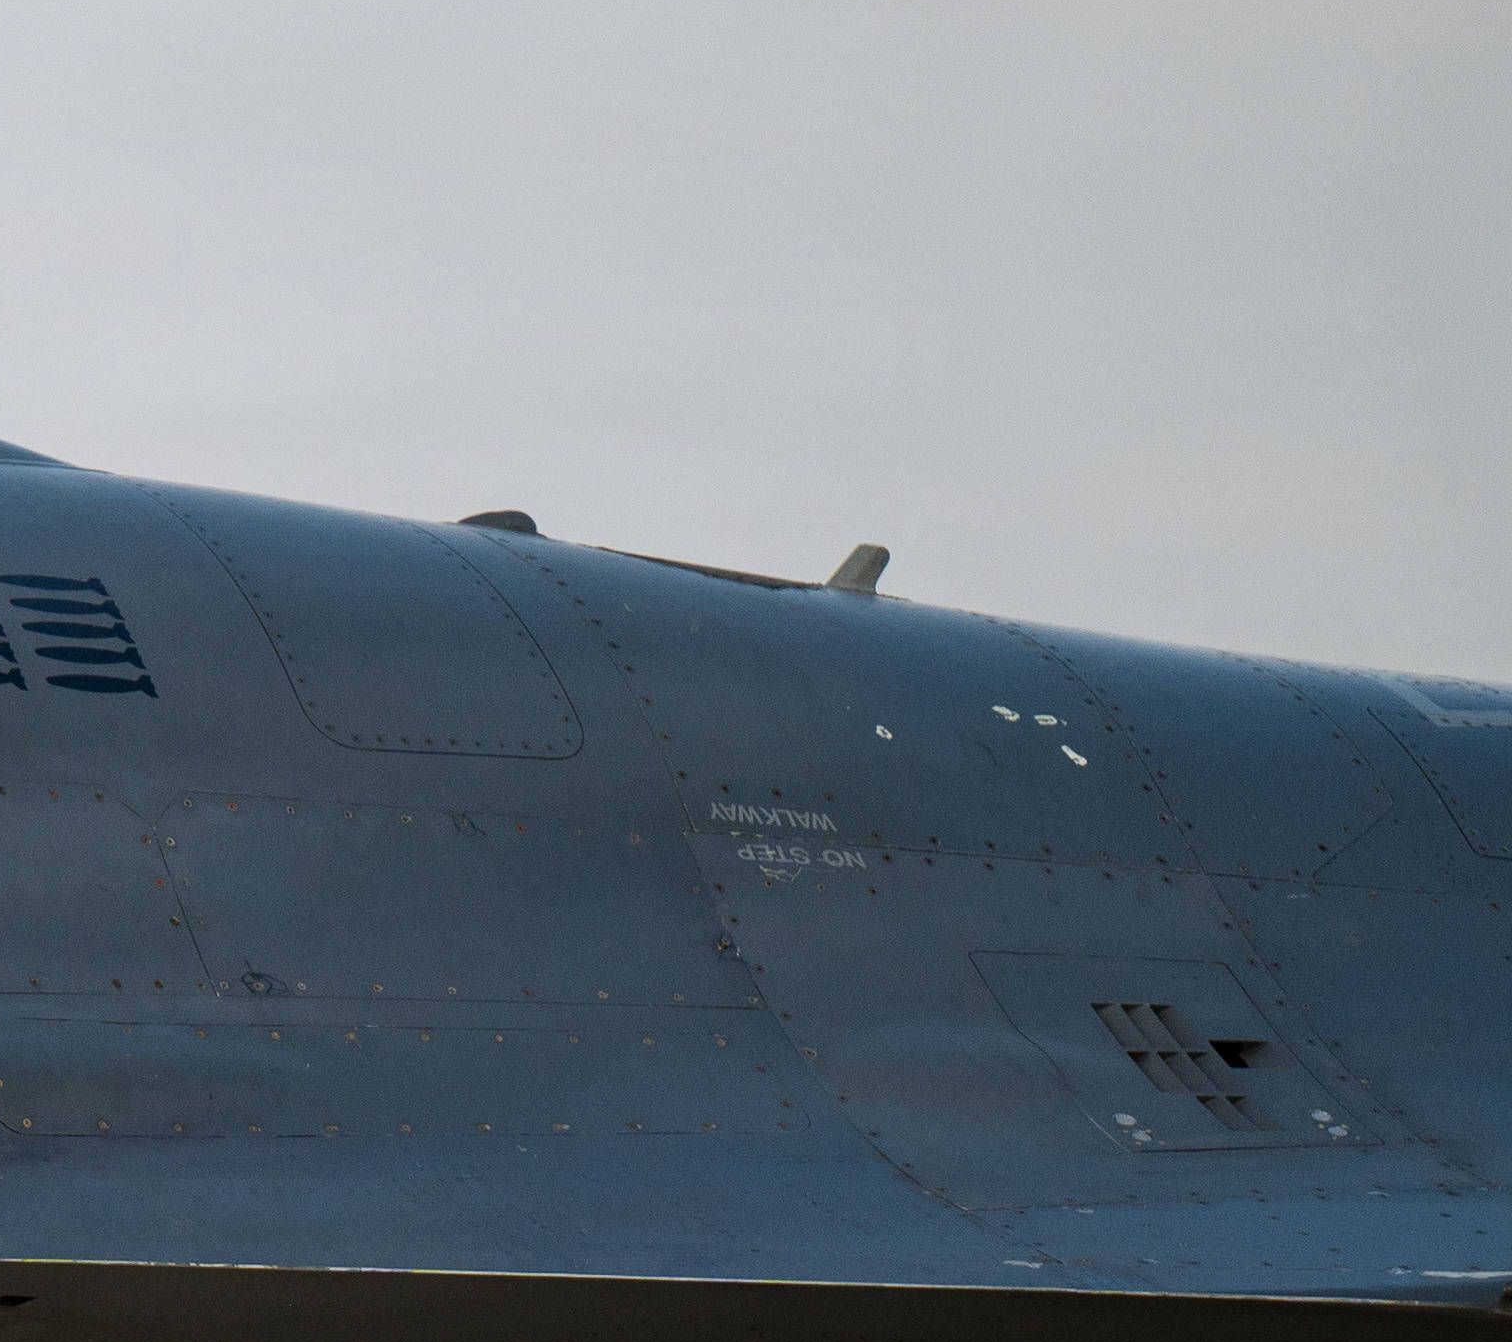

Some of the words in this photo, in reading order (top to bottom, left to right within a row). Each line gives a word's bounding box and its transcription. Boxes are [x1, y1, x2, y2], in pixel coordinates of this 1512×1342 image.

[710, 802, 838, 832] WALKWAY
[737, 844, 810, 864] STEP
[821, 849, 867, 869] NO
